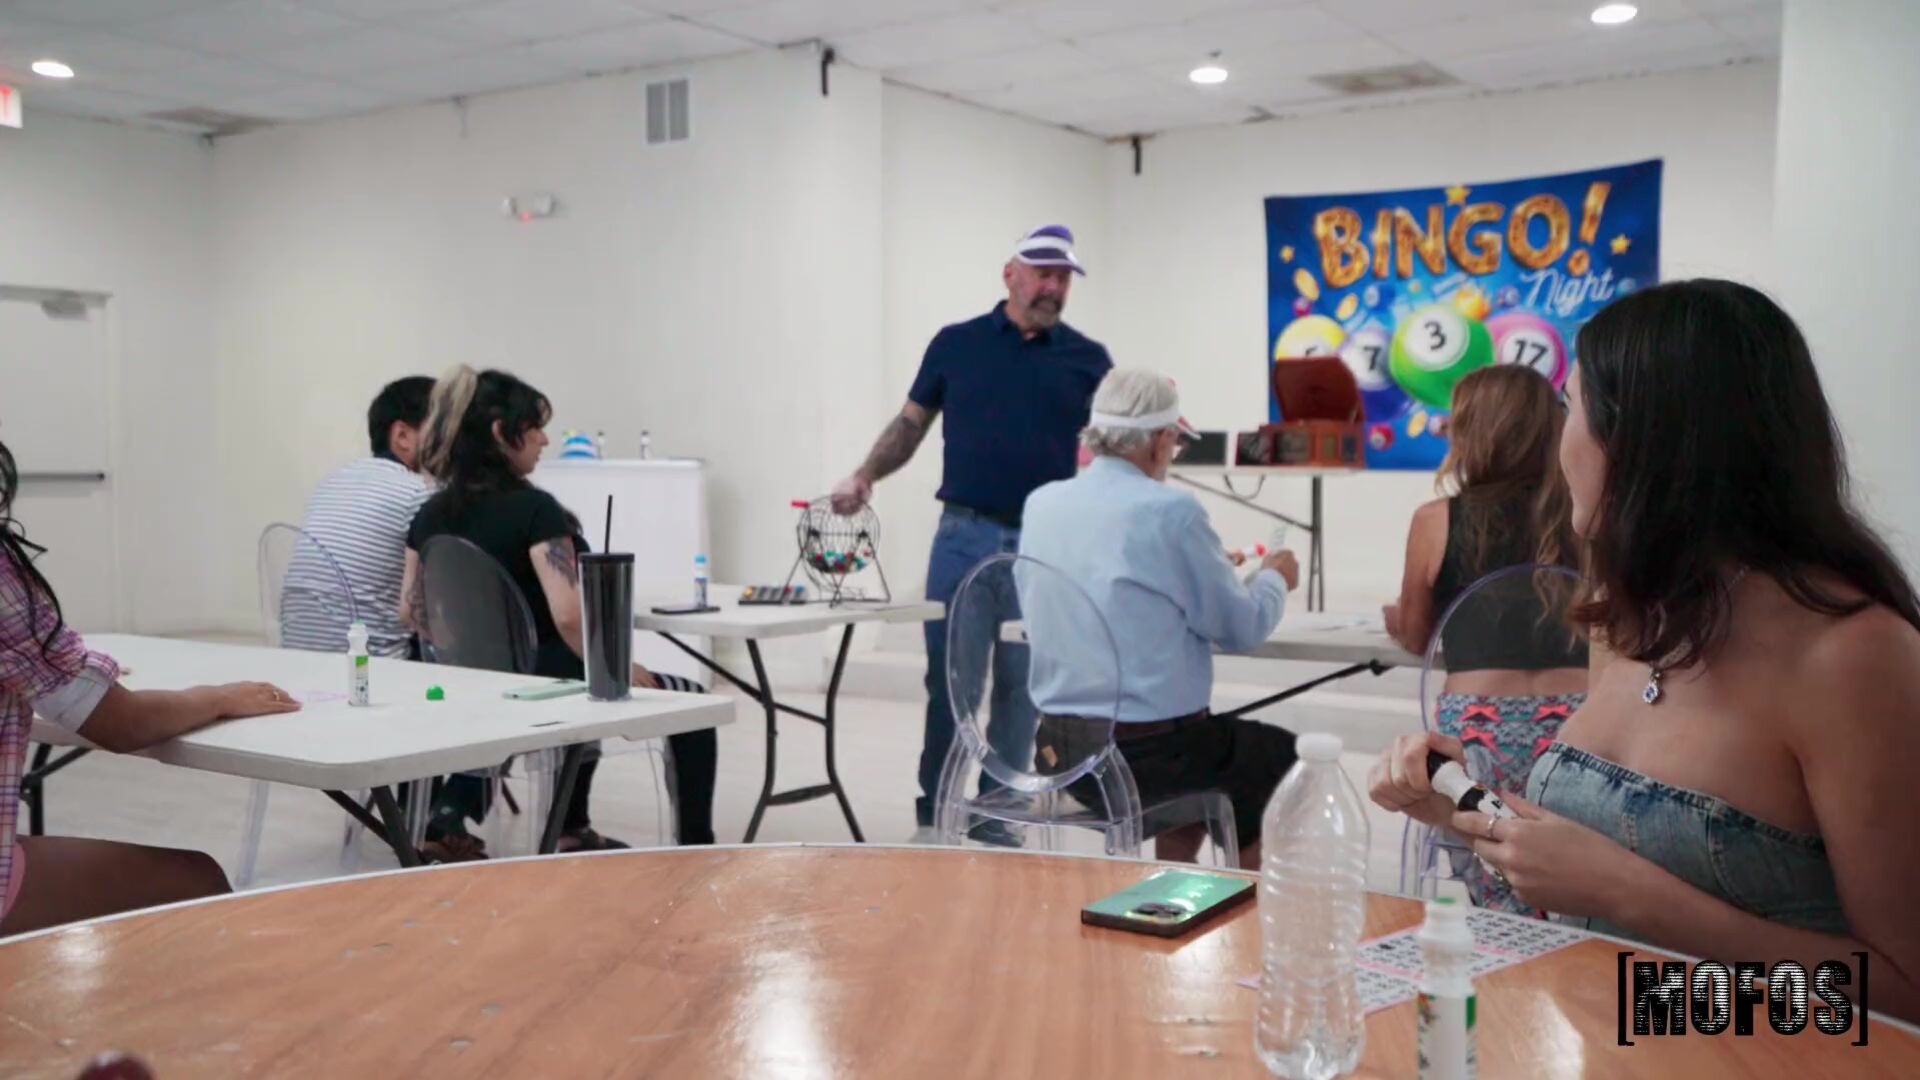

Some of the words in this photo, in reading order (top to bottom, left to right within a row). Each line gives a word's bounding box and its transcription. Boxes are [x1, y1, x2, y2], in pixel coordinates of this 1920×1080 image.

[1313, 182, 1611, 288] BINGO!
[1518, 266, 1615, 318] Night
[1424, 320, 1446, 351] 3
[1363, 345, 1382, 371] 7
[1515, 339, 1549, 369] 17
